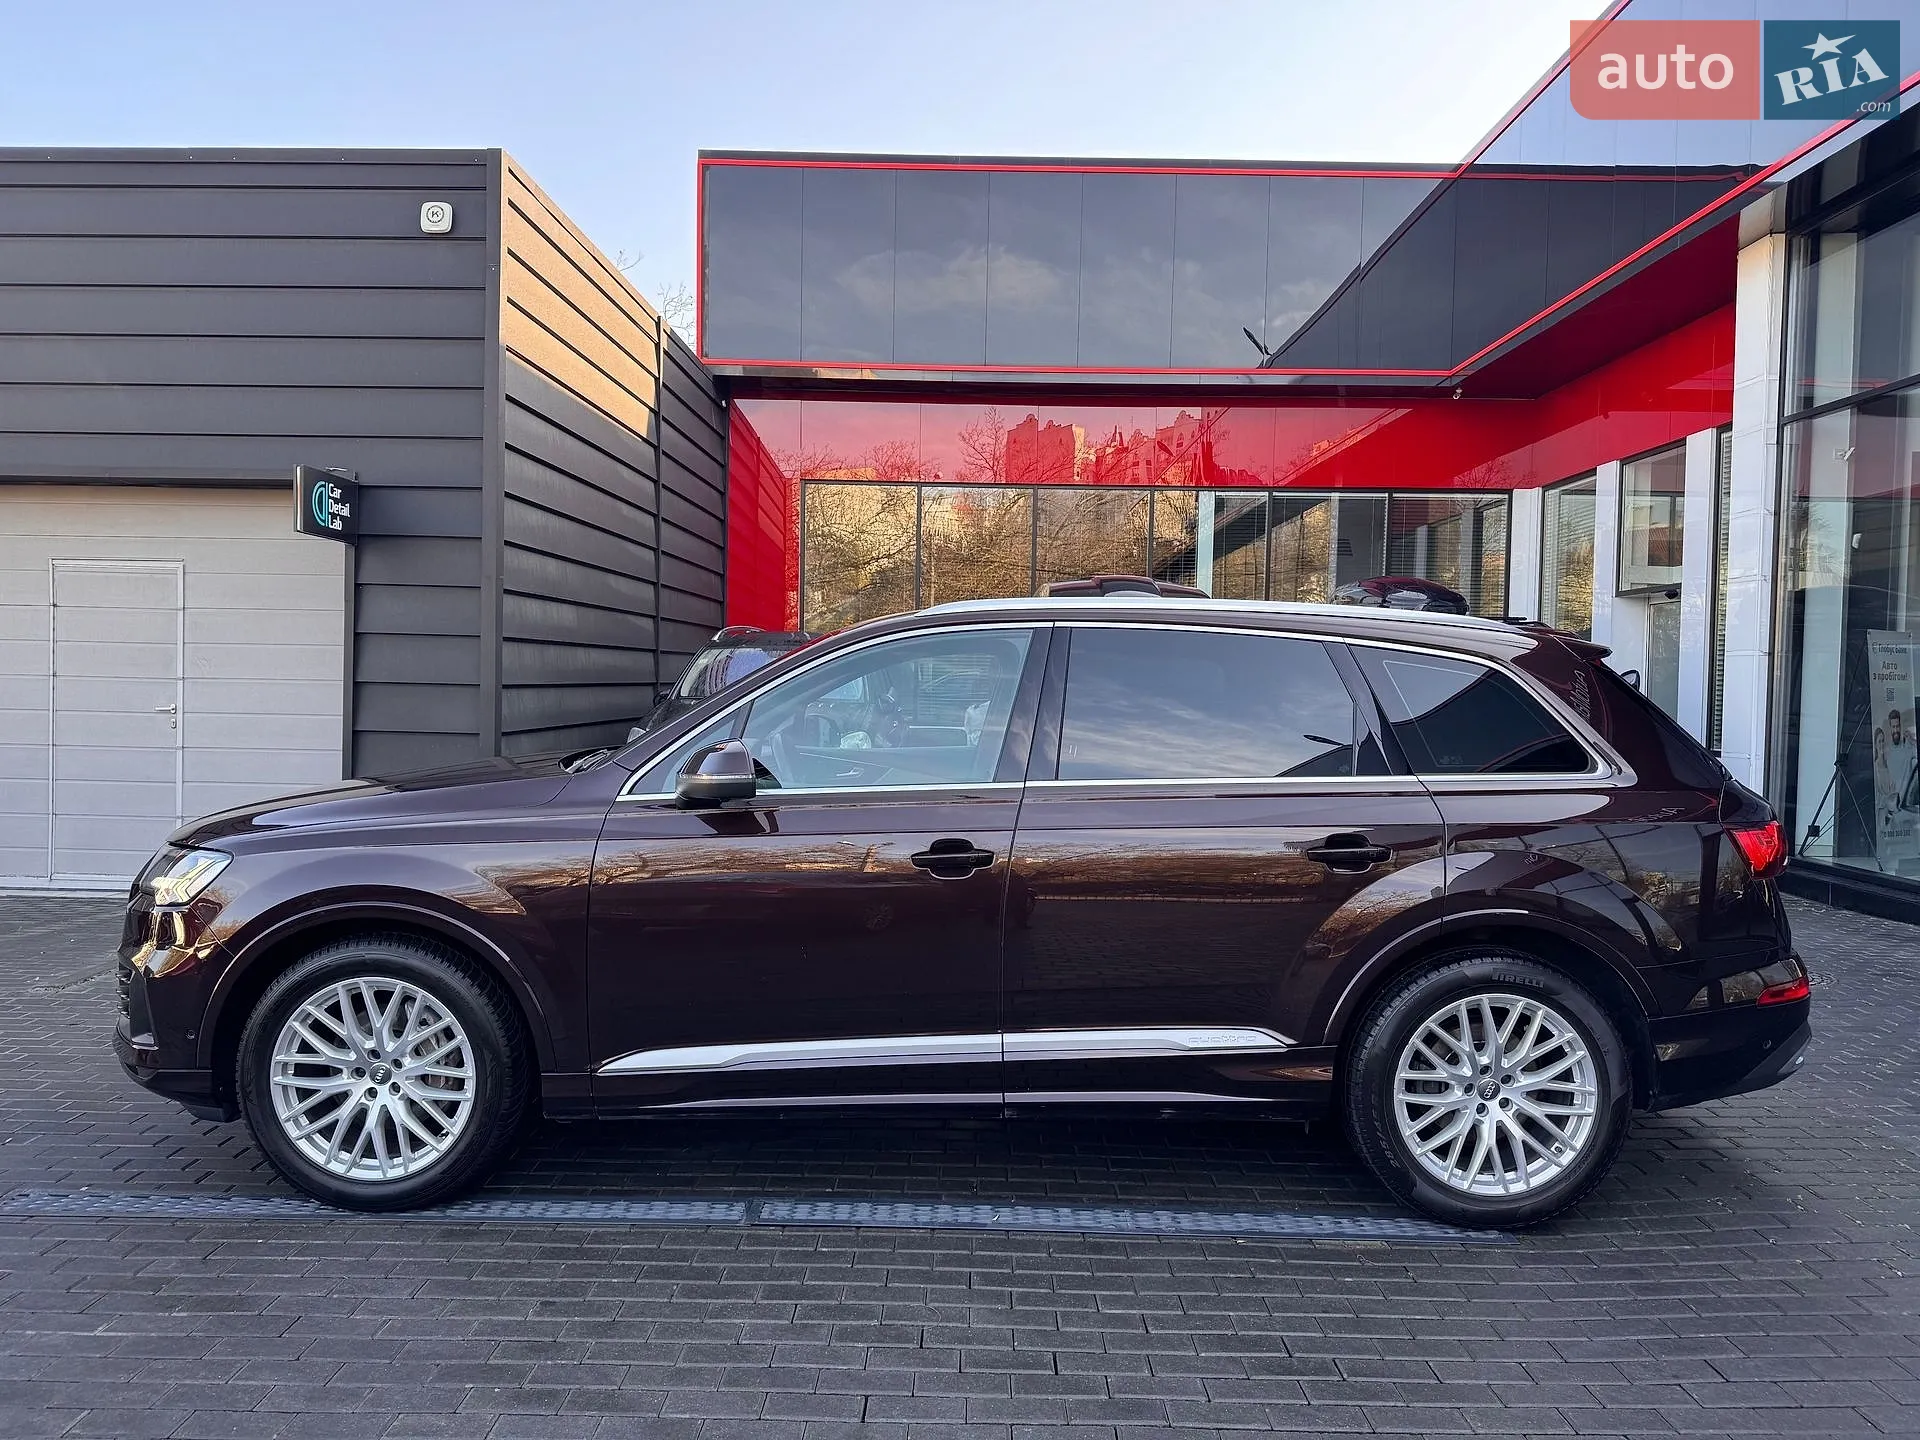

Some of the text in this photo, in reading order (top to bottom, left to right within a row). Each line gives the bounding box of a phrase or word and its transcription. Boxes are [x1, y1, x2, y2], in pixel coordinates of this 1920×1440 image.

[328, 483, 342, 499] Car
[328, 499, 350, 518] Detail
[328, 514, 343, 531] Lab
[1881, 660, 1898, 671] Авто
[1492, 972, 1544, 988] PIRELLI
